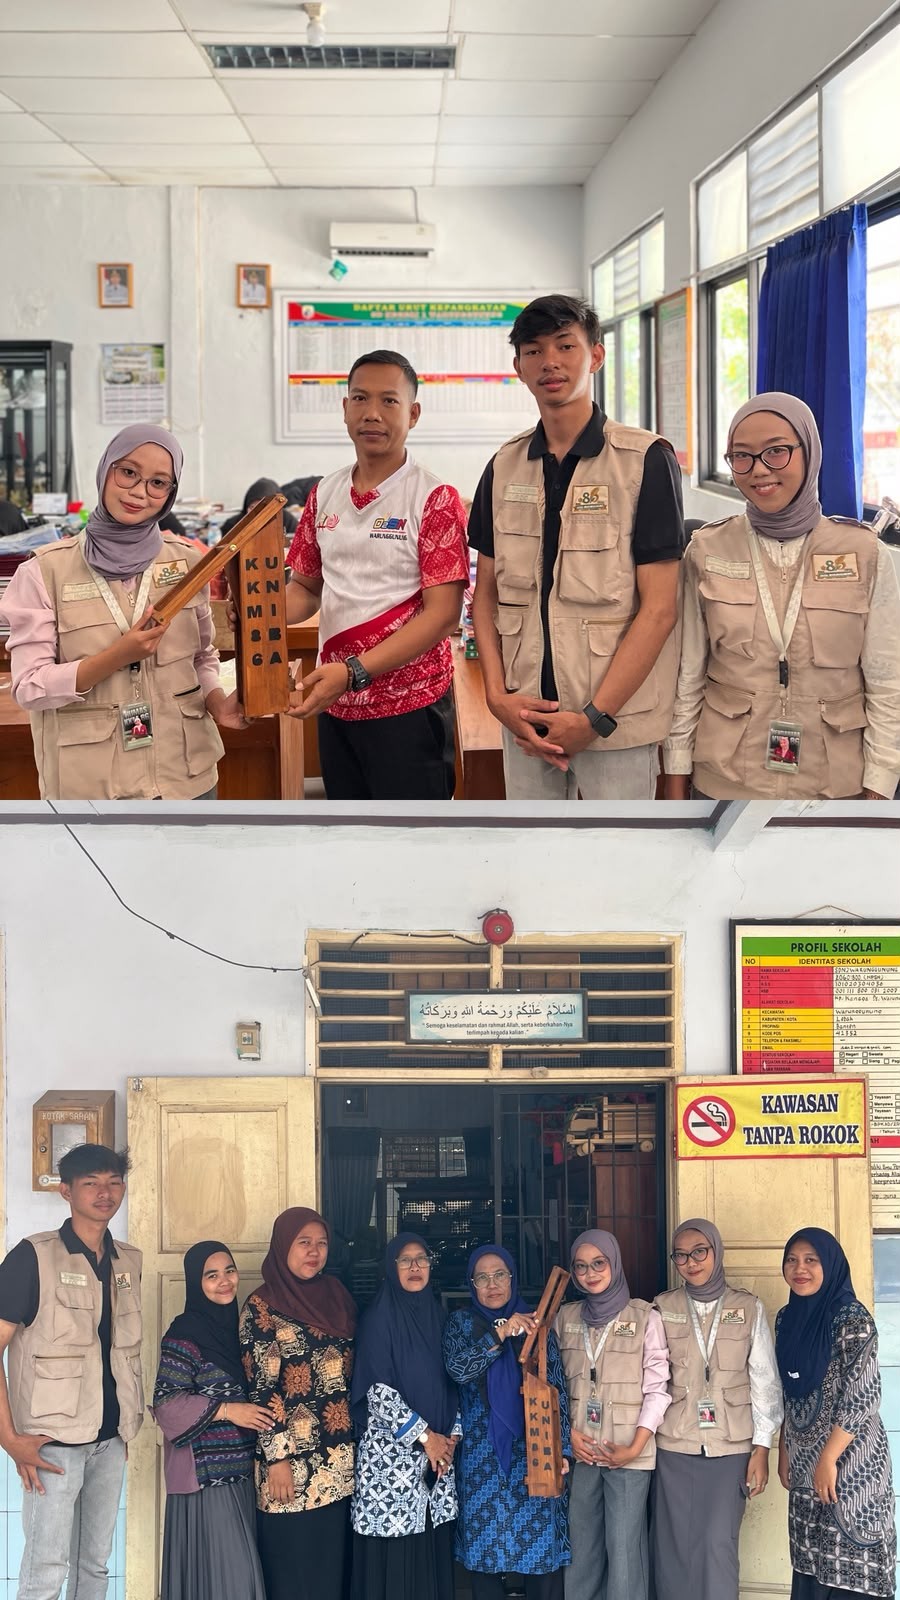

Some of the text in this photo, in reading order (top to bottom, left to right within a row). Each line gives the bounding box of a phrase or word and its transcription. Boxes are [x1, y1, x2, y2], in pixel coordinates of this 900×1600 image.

[265, 556, 282, 665] UNIBA
[790, 942, 882, 952] PROFIL SEKOLAH
[761, 1093, 839, 1114] KAWASAN
[743, 1124, 860, 1145] TANPA ROKOK
